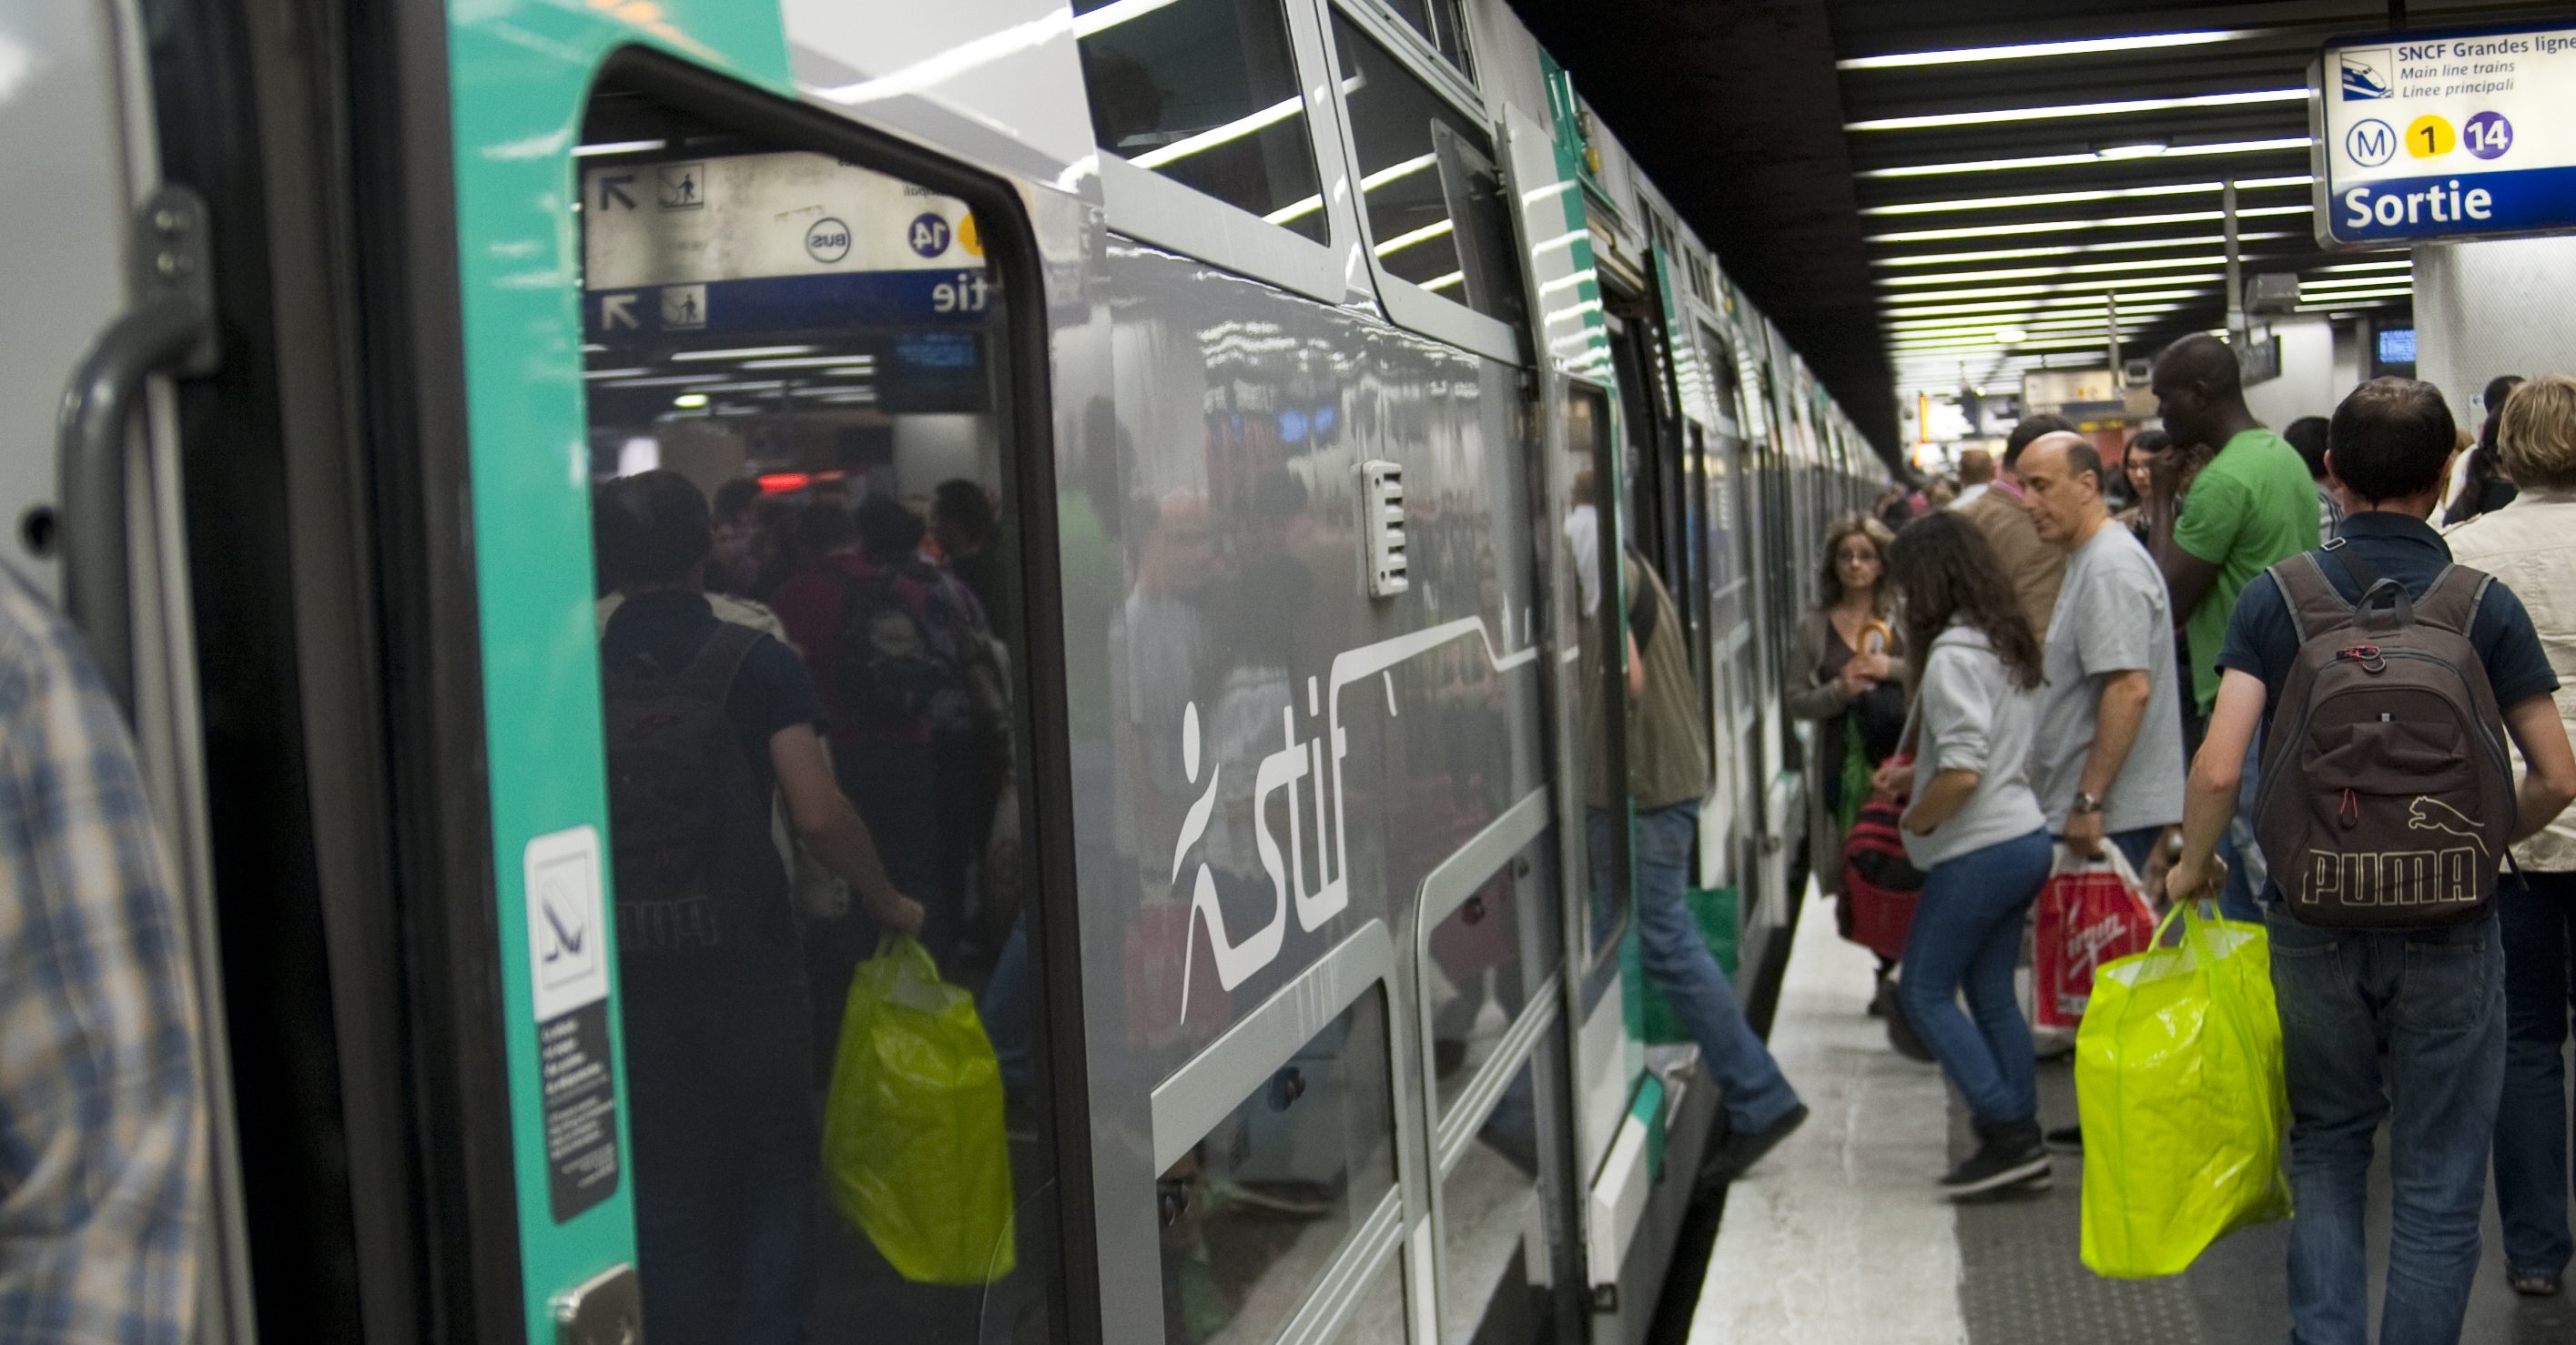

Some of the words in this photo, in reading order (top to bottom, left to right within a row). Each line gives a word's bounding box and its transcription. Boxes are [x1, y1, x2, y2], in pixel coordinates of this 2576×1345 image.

[2398, 44, 2447, 62] SNCF
[2453, 38, 2529, 57] Grandes
[2400, 66, 2438, 79] Main
[2442, 64, 2469, 76] line
[2473, 60, 2516, 74] trains
[2402, 85, 2441, 98] Linee
[2445, 78, 2515, 97] principali
[2357, 128, 2386, 158] M
[2420, 126, 2436, 154] 1
[2466, 119, 2509, 152] 14
[2344, 179, 2492, 228] Sortie
[2301, 846, 2477, 906] PUMA
